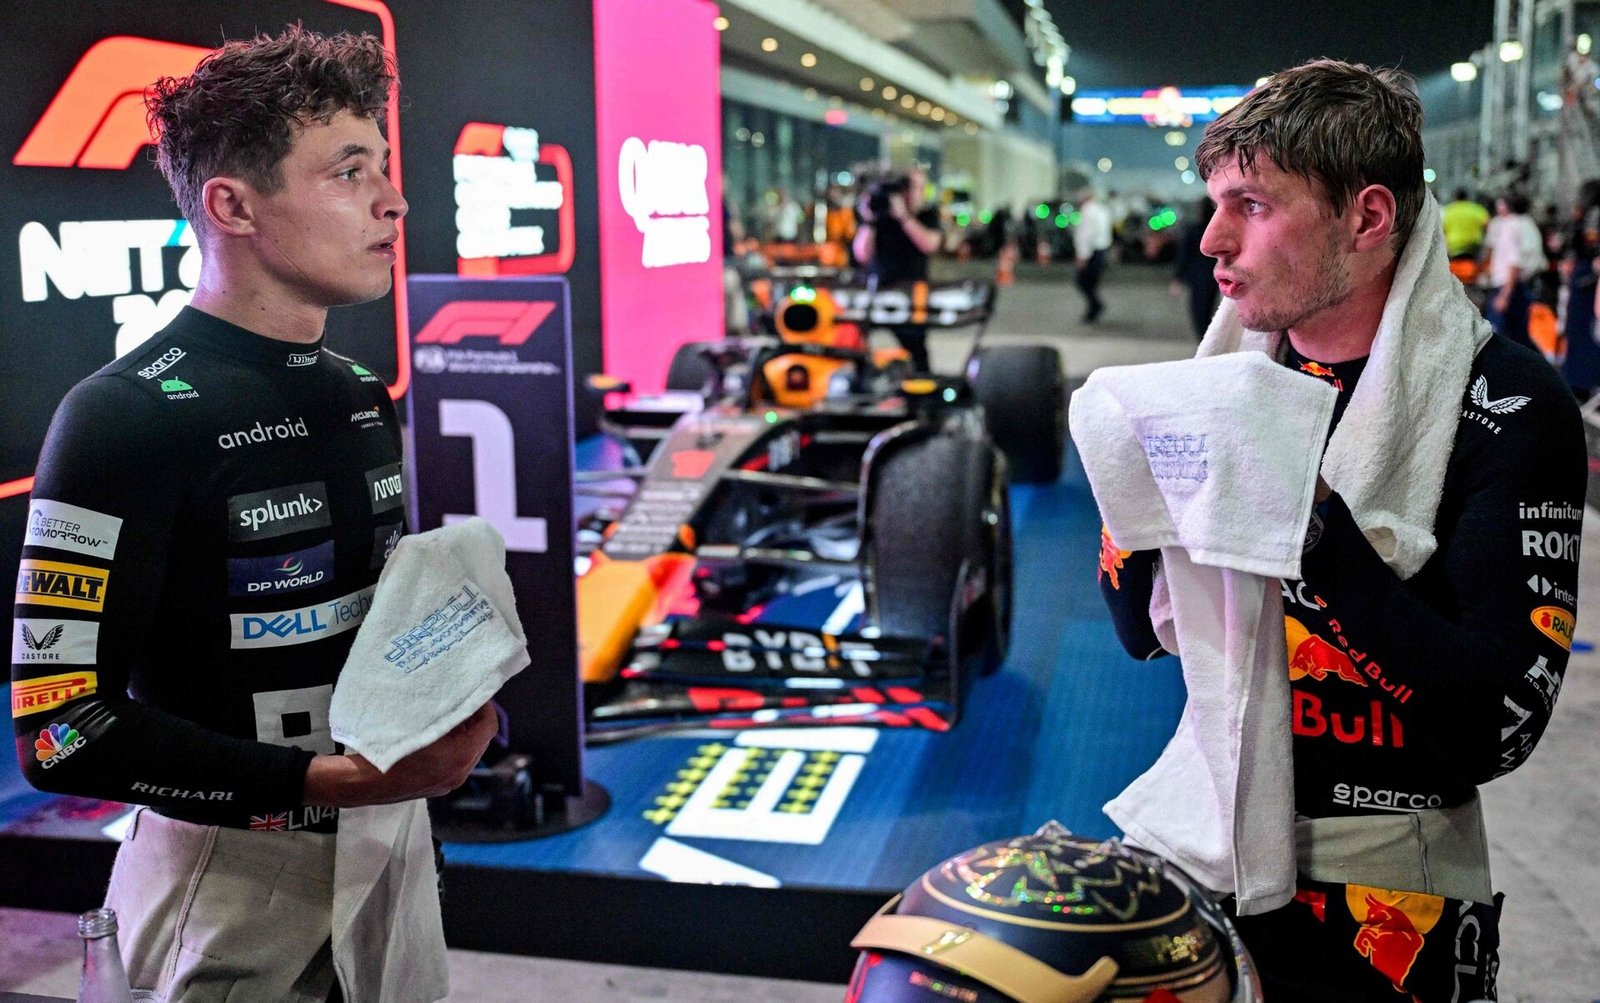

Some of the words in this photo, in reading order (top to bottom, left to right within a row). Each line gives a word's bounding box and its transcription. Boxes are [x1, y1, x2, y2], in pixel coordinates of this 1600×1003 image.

[138, 347, 187, 380] sparco
[167, 390, 200, 400] android
[218, 417, 309, 450] android
[1462, 410, 1502, 435] ASTORE
[439, 399, 548, 552] 1
[41, 517, 81, 532] BETTER
[247, 582, 272, 592] DP
[275, 571, 324, 589] WORLD
[243, 609, 327, 638] DELL
[1328, 618, 1367, 663] Red
[1364, 661, 1413, 703] Bull
[1293, 689, 1404, 748] Bull
[41, 736, 87, 770] CNBC
[1333, 783, 1442, 812] sparco
[288, 805, 339, 830] LN4
